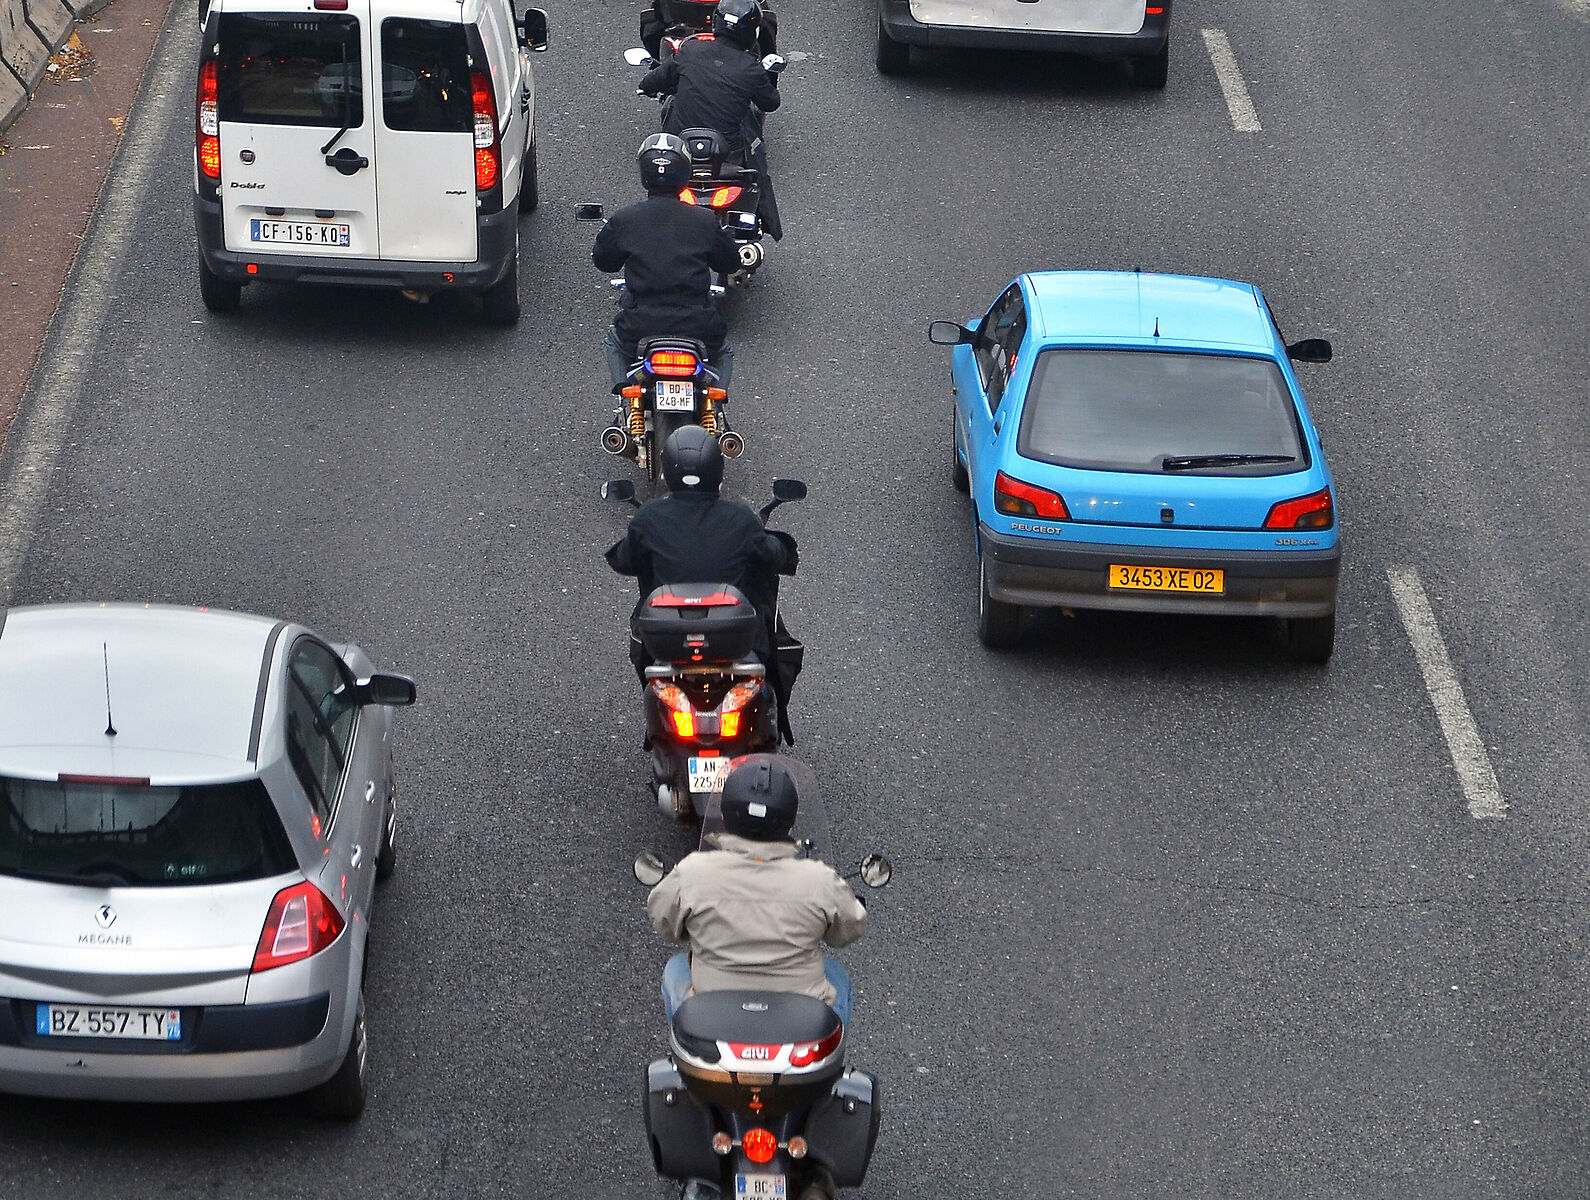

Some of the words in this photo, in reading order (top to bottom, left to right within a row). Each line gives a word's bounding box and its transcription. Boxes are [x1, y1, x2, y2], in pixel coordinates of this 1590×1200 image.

[262, 223, 338, 243] CF-156-KQ
[1010, 522, 1062, 536] PEUGEOT
[1275, 537, 1297, 546] 306
[1119, 567, 1163, 587] 3453
[1167, 569, 1189, 589] XE
[1193, 571, 1215, 590] 02
[693, 776, 726, 789] 225-B
[51, 1009, 166, 1035] BZ-557-TY
[741, 1047, 769, 1060] GIVI
